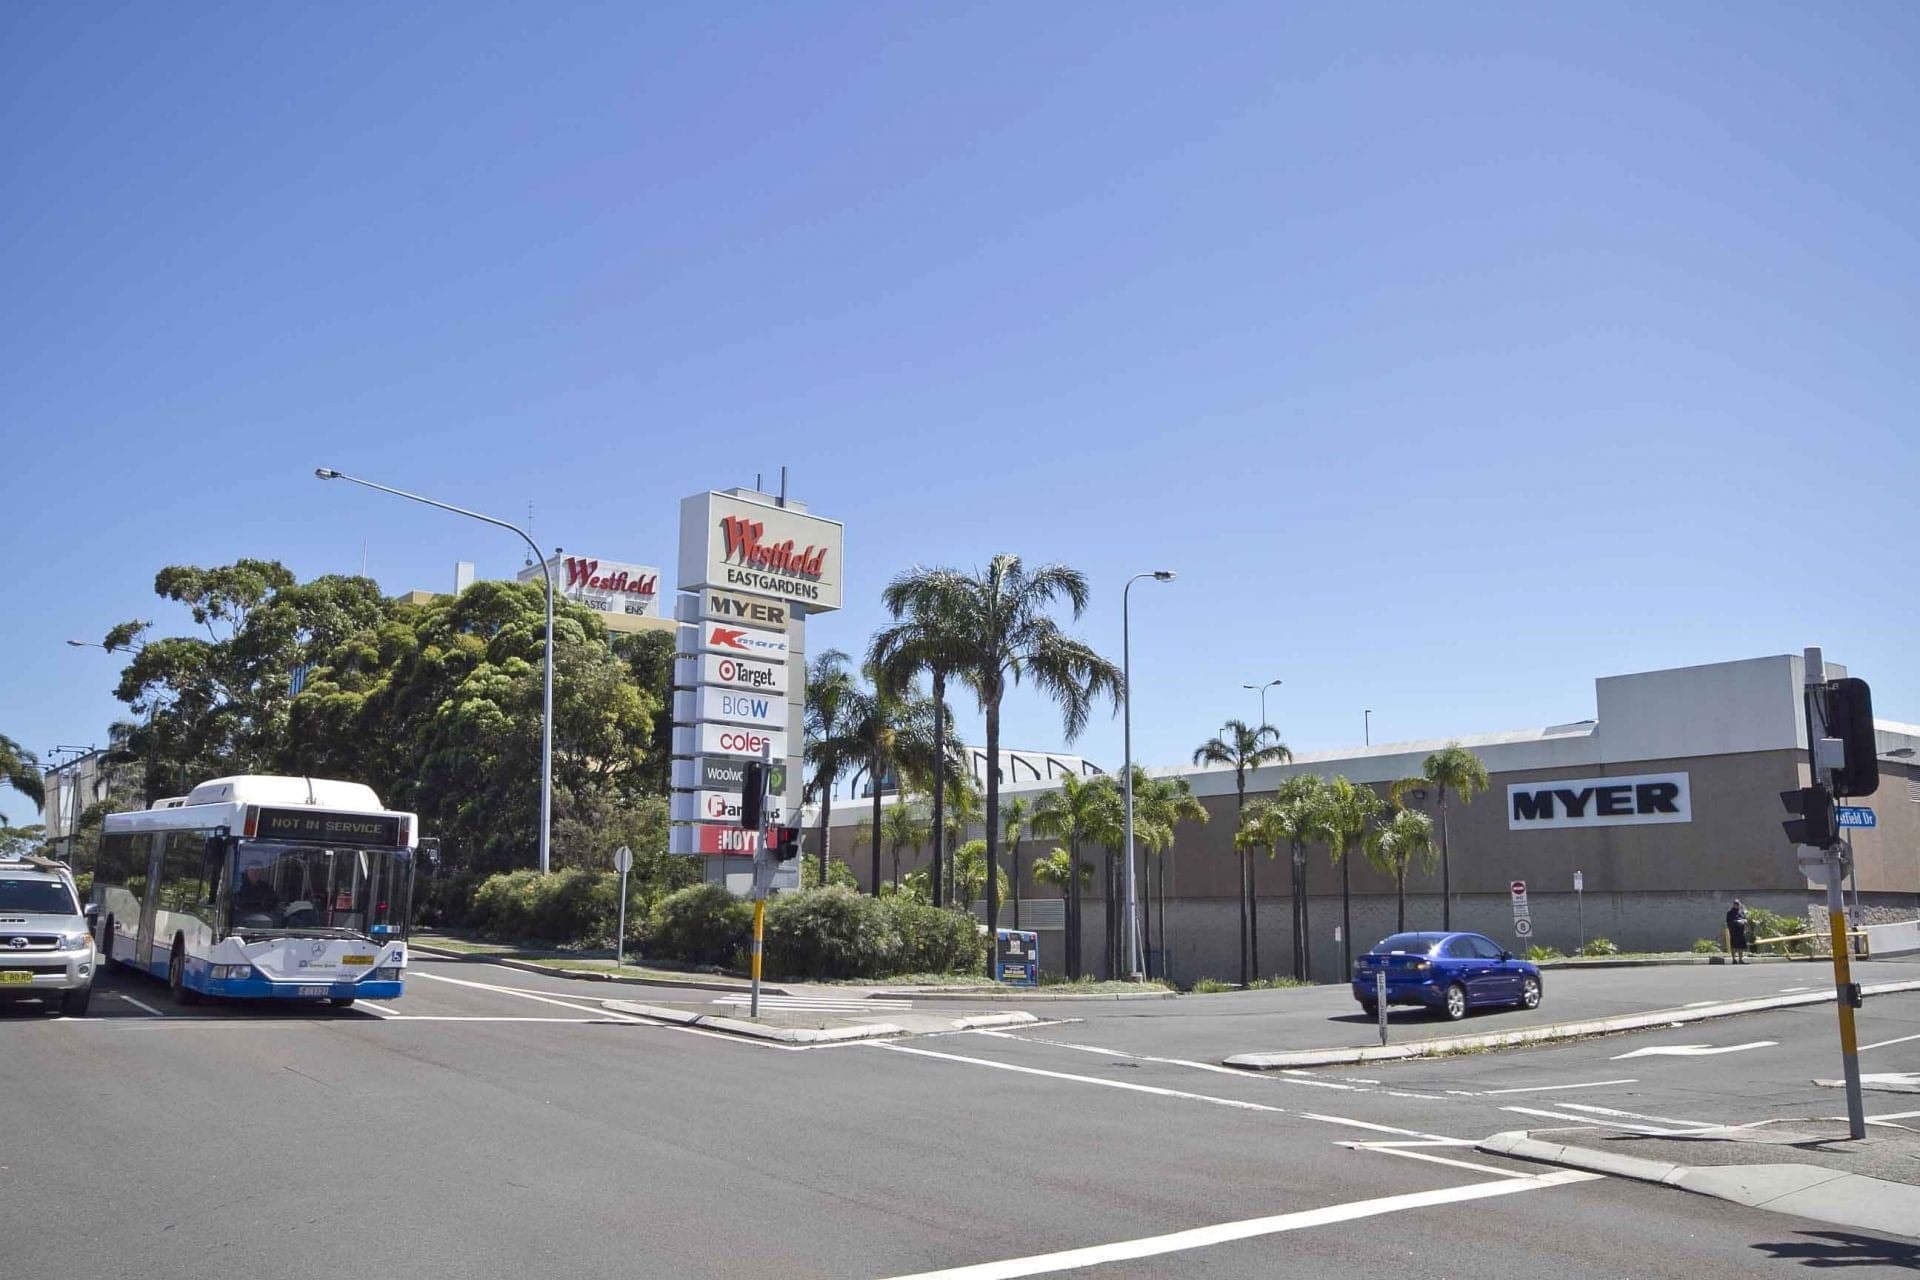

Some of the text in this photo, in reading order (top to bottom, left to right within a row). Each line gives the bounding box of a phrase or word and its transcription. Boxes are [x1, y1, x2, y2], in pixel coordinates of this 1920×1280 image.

[721, 515, 828, 579] Westfield
[564, 557, 657, 595] Westfield
[727, 568, 819, 600] EASTGARDENS
[710, 596, 785, 624] MYER
[709, 628, 787, 651] Kmart
[1512, 782, 1680, 821] MYER
[271, 817, 383, 834] NOT IN SERVICE
[1862, 812, 1872, 825] Dr
[722, 830, 767, 851] HOYT
